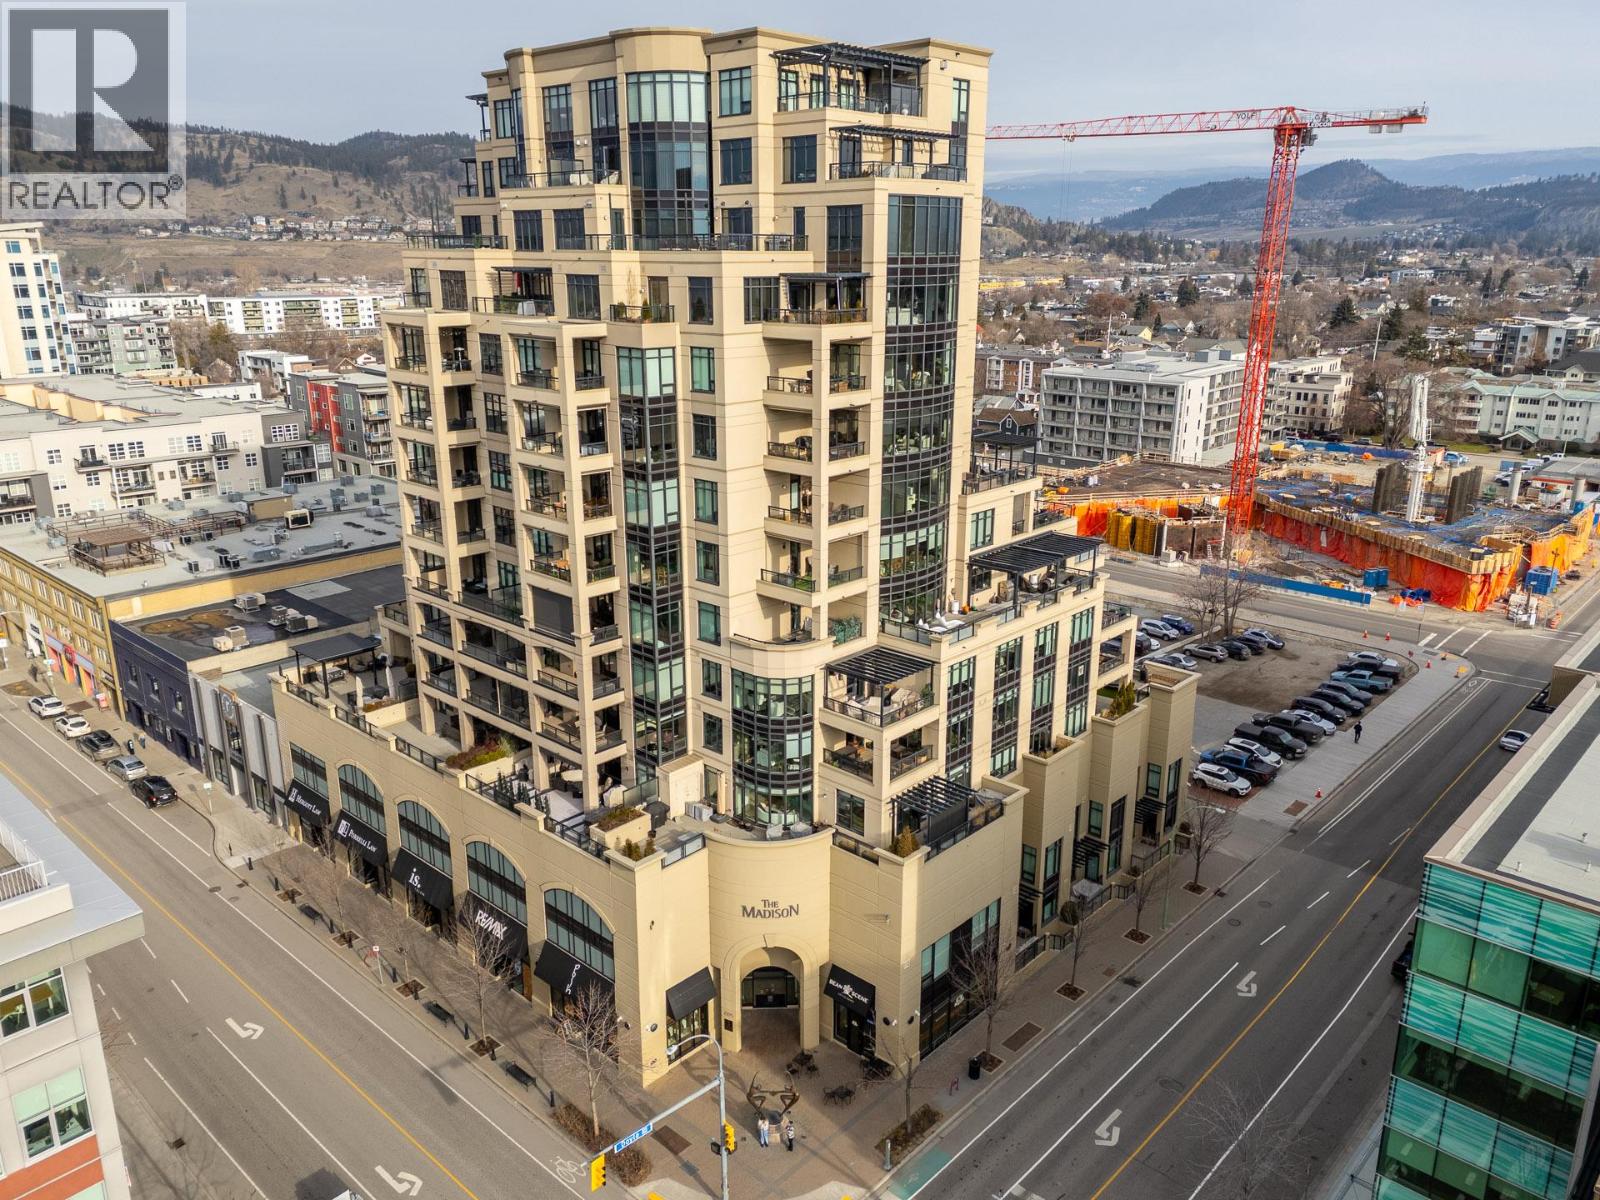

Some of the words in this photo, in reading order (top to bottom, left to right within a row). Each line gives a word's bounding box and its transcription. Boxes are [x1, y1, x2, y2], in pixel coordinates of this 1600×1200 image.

[741, 904, 799, 919] MADISON
[761, 899, 779, 909] THE
[475, 909, 508, 941] RE/MAX
